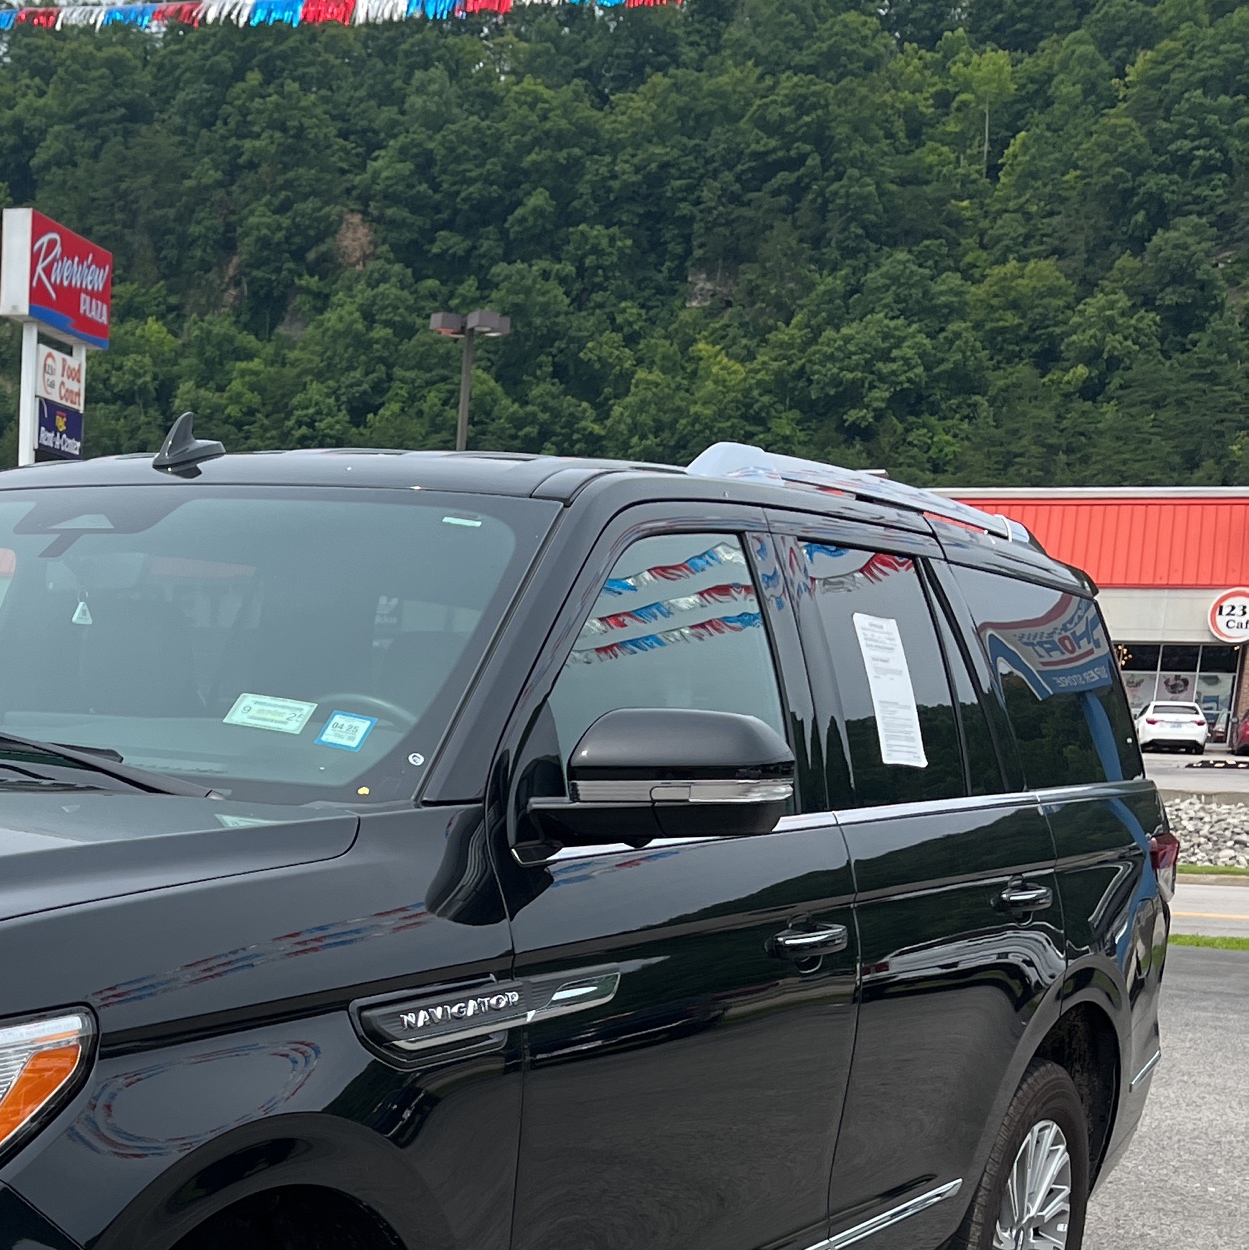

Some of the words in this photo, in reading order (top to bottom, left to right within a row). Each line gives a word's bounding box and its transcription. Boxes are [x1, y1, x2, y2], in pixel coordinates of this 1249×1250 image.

[32, 232, 109, 300] Riverview
[80, 293, 108, 324] PLAZA
[61, 357, 82, 384] Food
[59, 381, 82, 407] Court
[1217, 604, 1247, 617] 123
[1226, 619, 1249, 630] Caf
[399, 991, 519, 1030] NAVIGATOR
